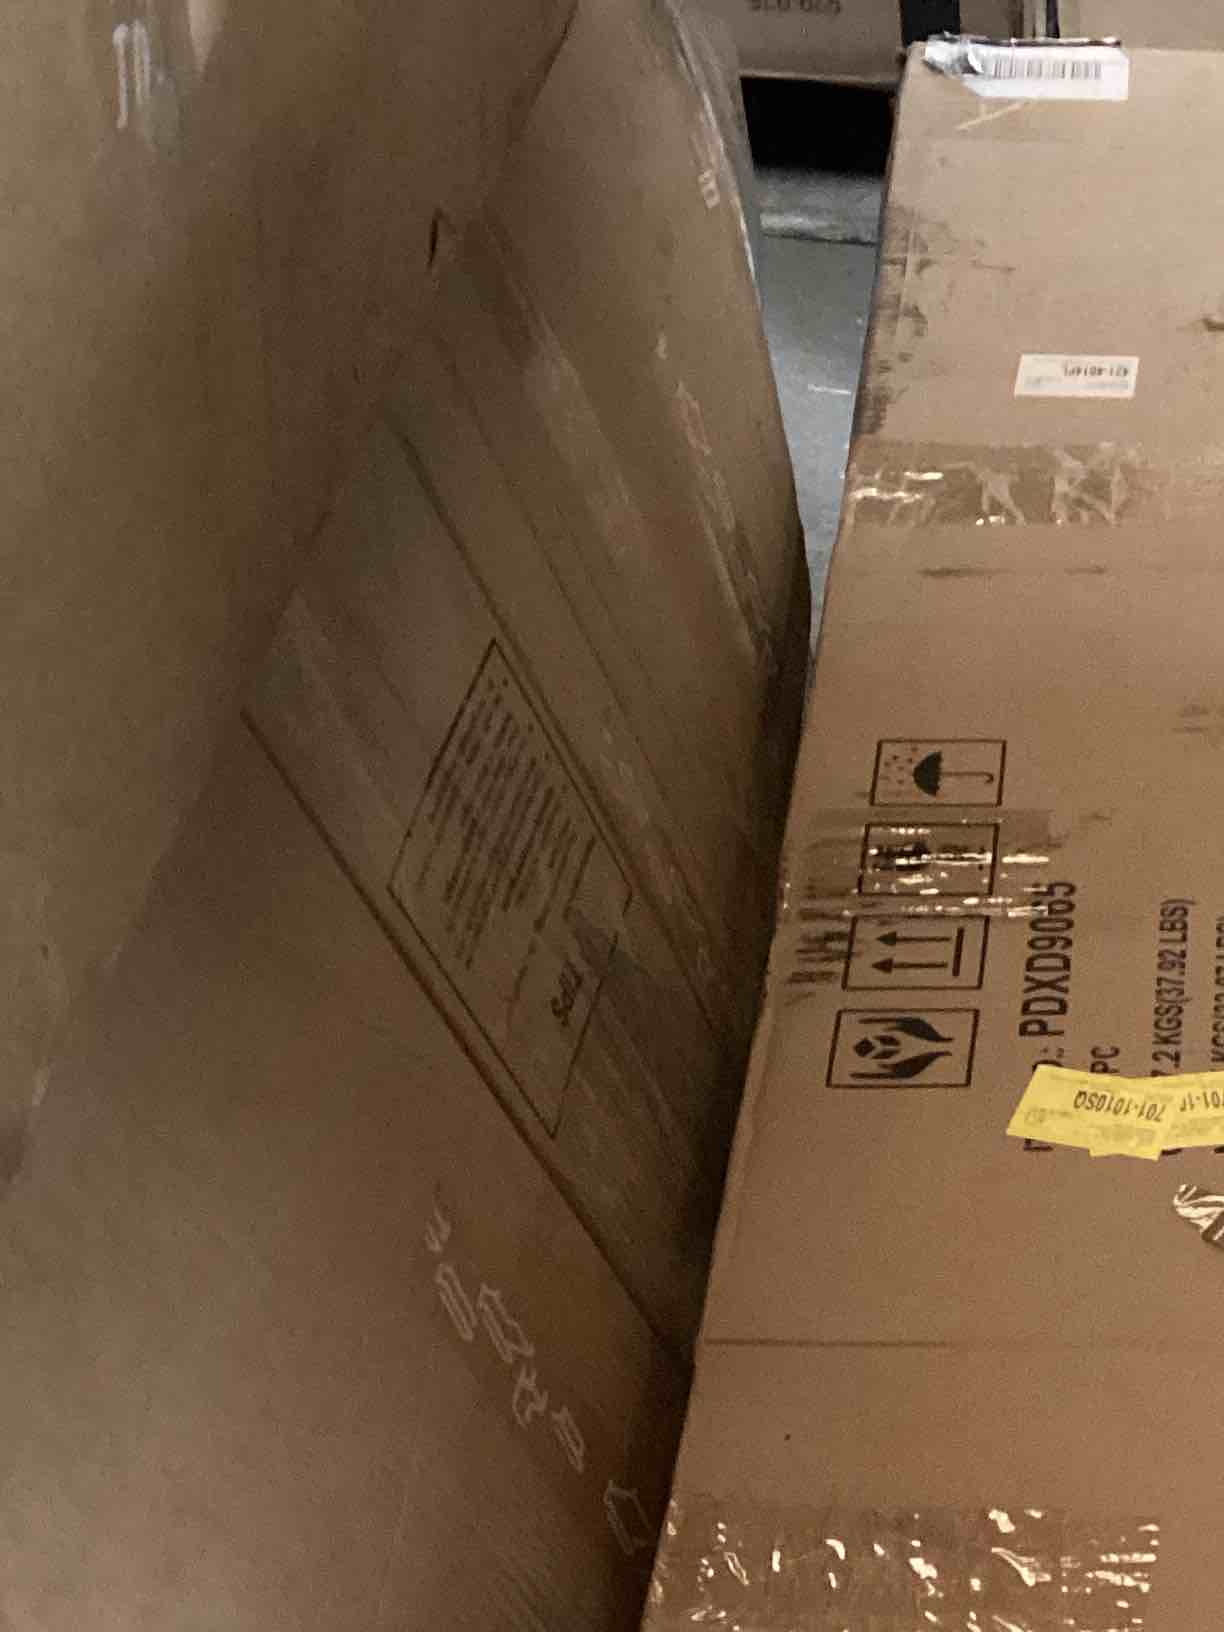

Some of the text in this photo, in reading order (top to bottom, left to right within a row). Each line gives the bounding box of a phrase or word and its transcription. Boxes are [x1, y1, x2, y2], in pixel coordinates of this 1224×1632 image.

[1018, 881, 1077, 1037] PDXD9065
[1159, 898, 1197, 943] LBS)
[1152, 949, 1193, 1046] KGS(37.92
